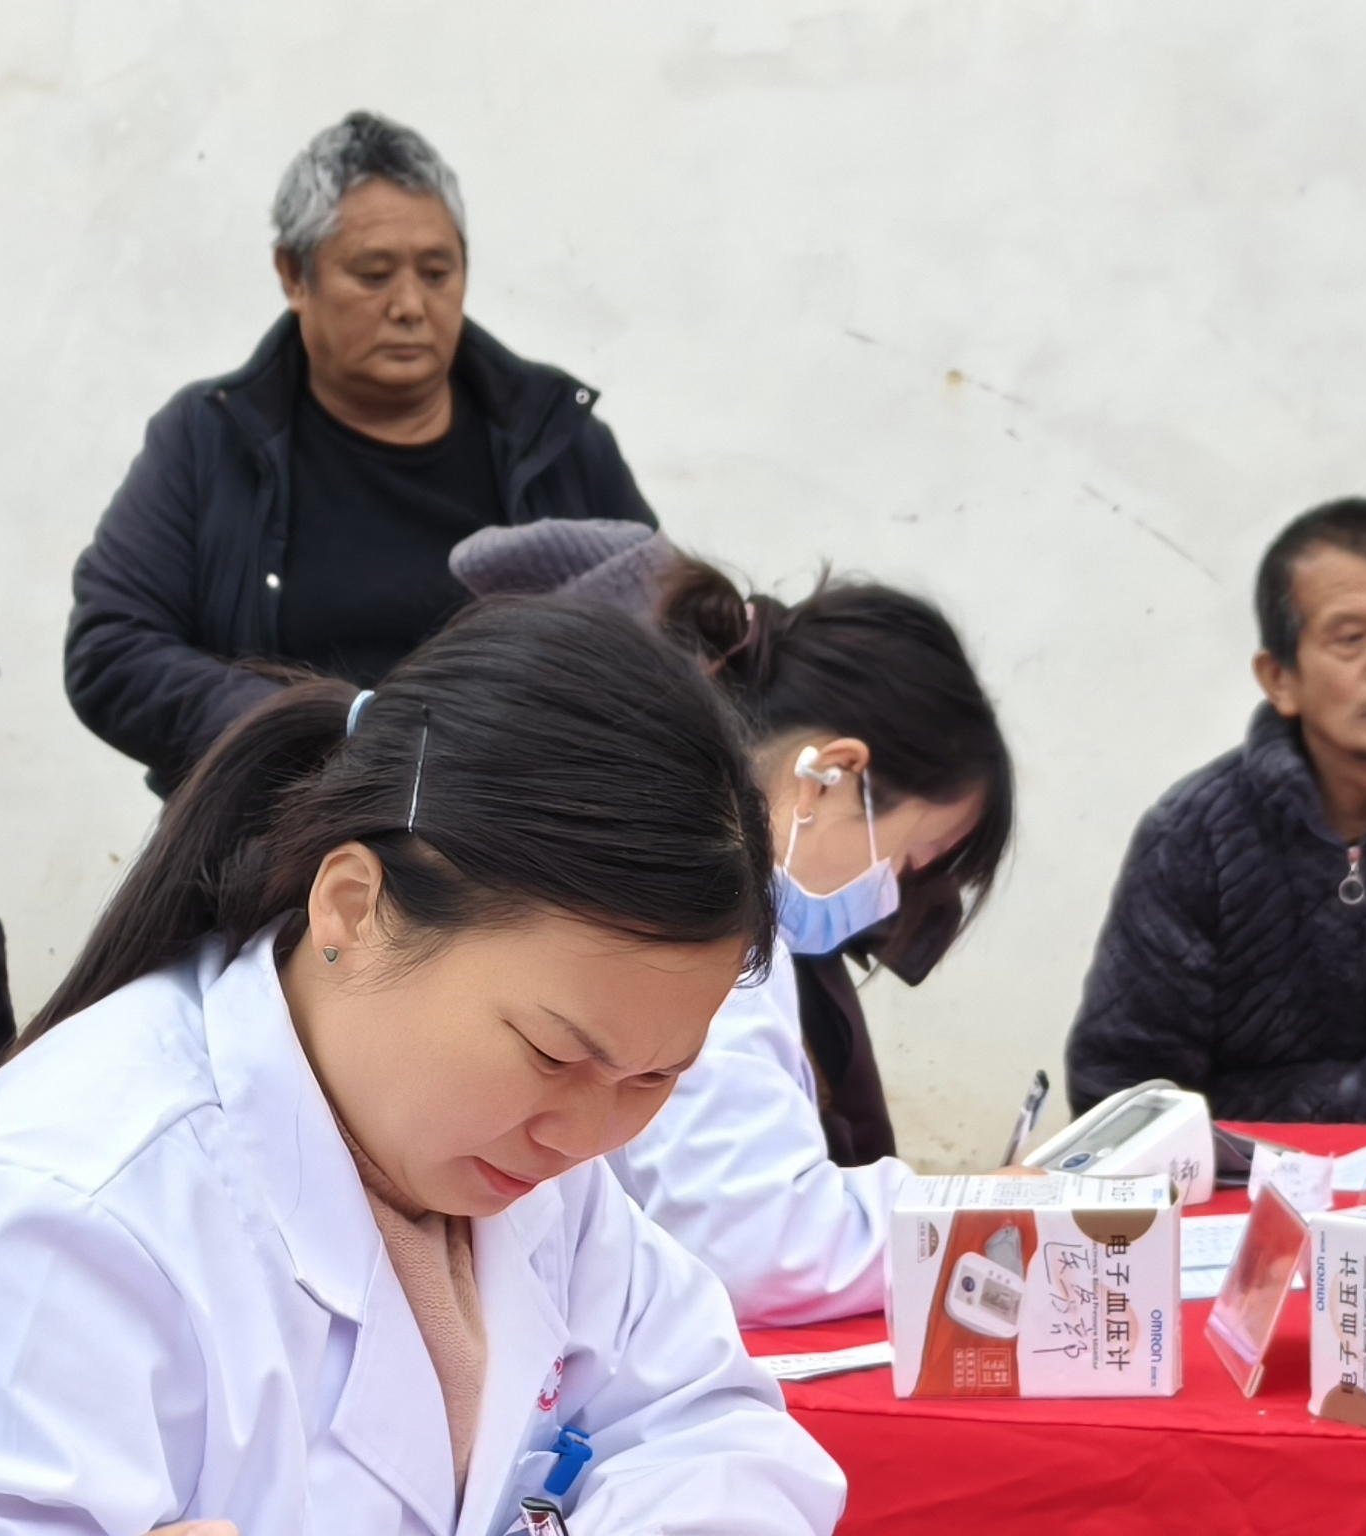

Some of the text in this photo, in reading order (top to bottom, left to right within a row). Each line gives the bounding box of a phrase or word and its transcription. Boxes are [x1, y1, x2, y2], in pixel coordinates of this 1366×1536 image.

[1033, 1241, 1091, 1359] 医务部
[1105, 1234, 1131, 1372] 电子血压计
[1150, 1309, 1163, 1363] OMRON
[1317, 1256, 1325, 1311] OMRON
[1339, 1251, 1358, 1394] 电子血压计
